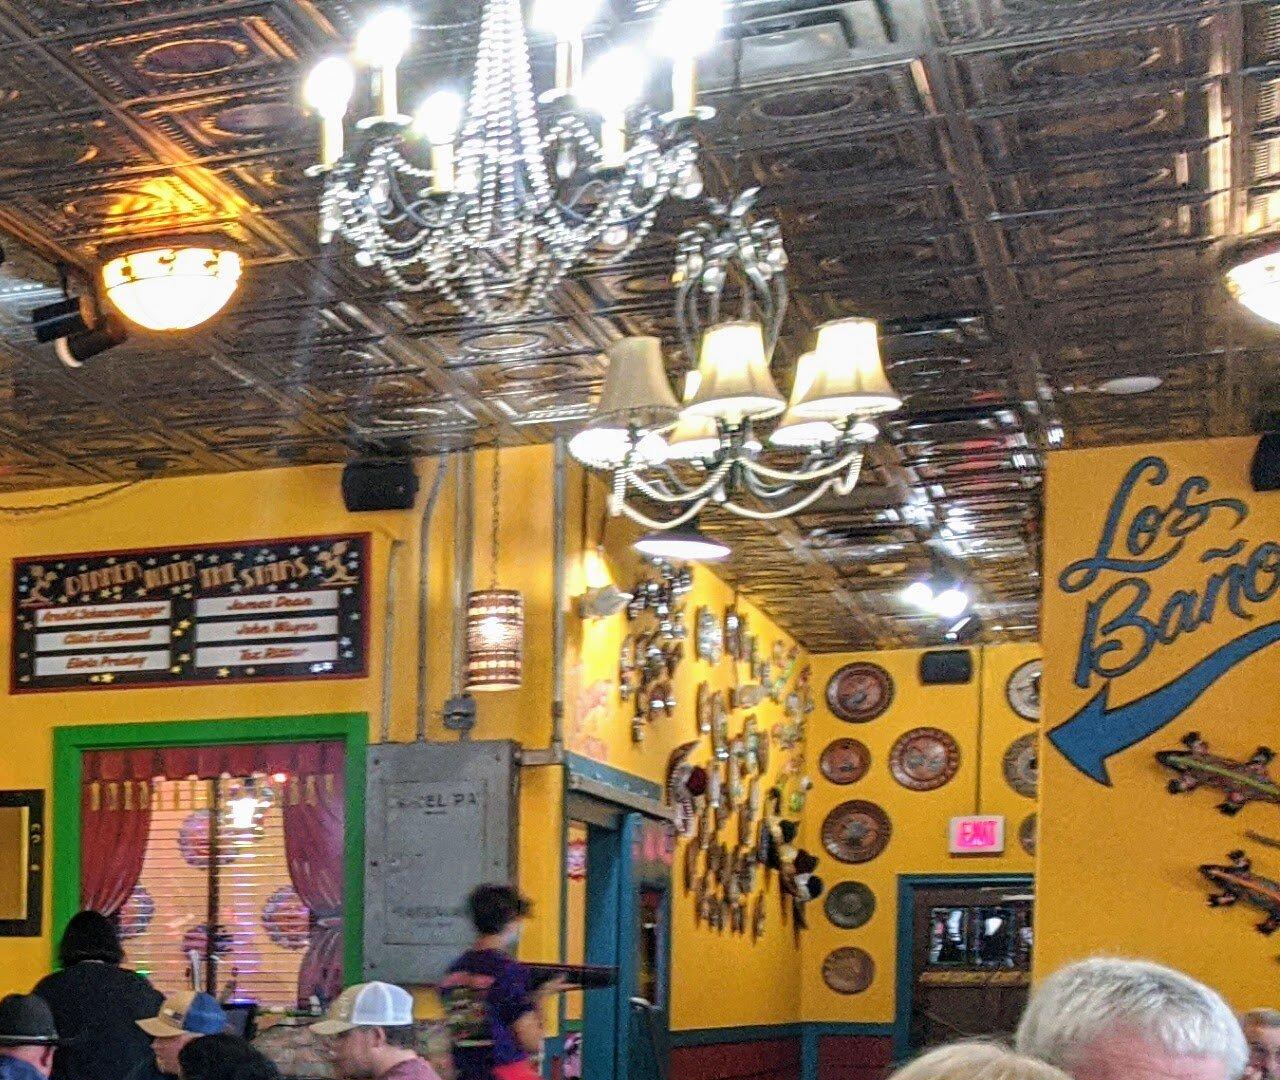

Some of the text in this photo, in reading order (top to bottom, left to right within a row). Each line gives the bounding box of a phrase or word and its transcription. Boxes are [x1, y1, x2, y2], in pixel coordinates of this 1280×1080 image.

[1057, 455, 1250, 594] Los
[240, 556, 310, 588] STARS
[1073, 538, 1280, 689] Baño
[236, 623, 271, 635] John
